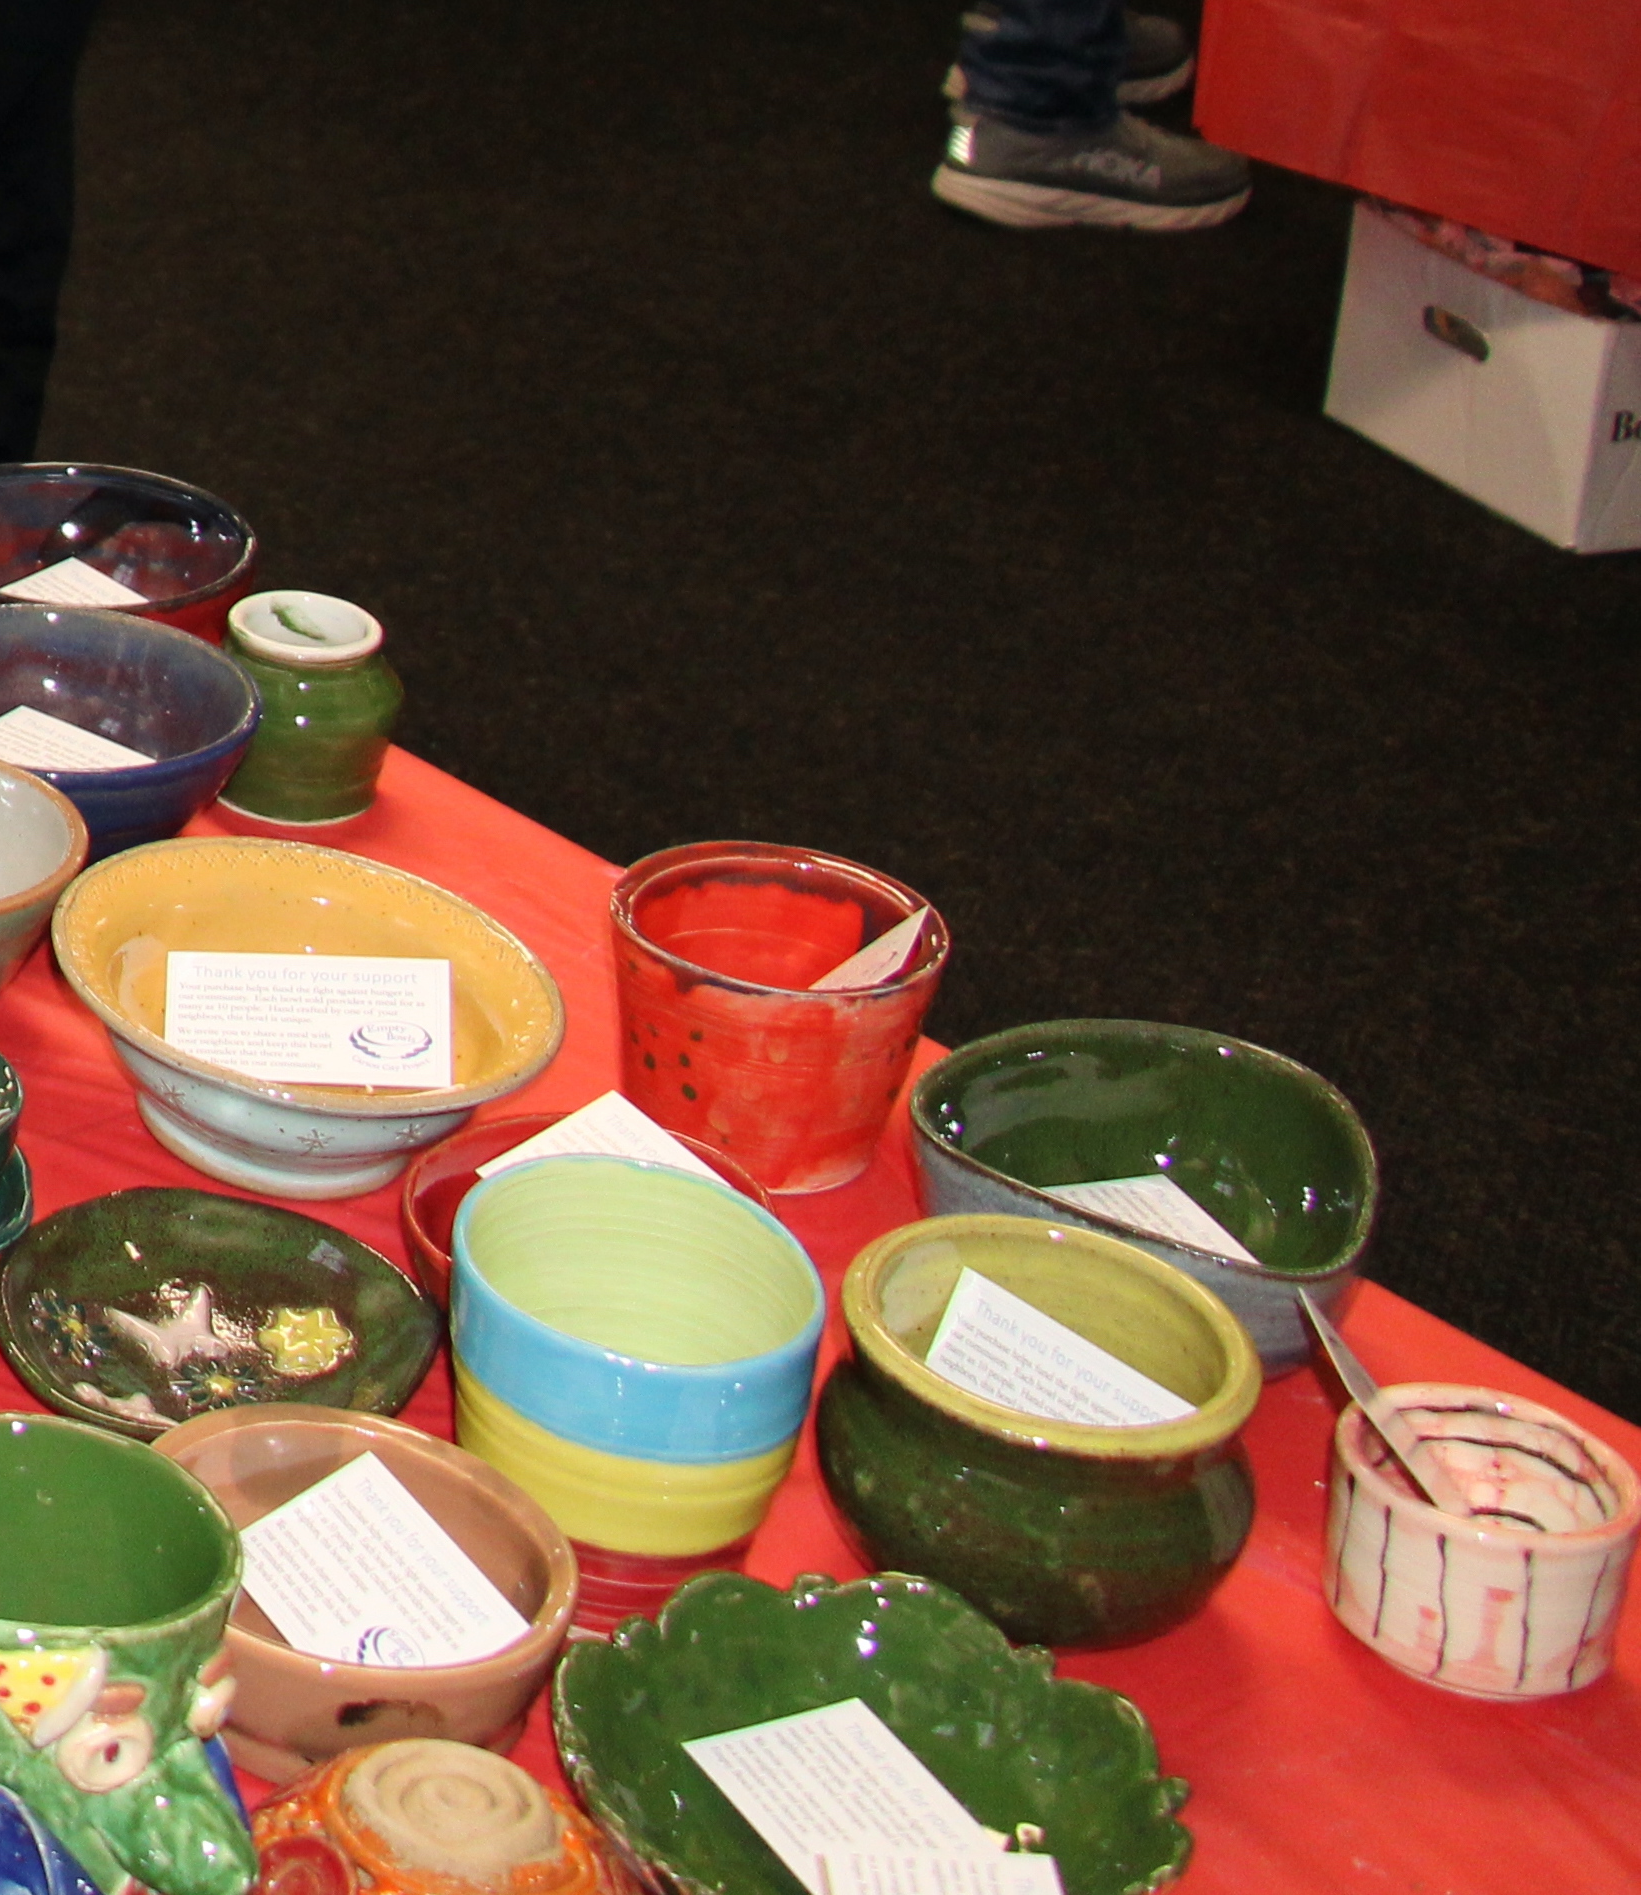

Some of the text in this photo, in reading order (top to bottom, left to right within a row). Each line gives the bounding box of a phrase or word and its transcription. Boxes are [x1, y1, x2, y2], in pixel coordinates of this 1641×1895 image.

[193, 964, 417, 985] Thank you for your support
[366, 1024, 407, 1034] Empty
[386, 1031, 416, 1044] Bowls
[351, 1054, 430, 1071] Carson City Project
[976, 1296, 1019, 1337] Thank
[1018, 1329, 1049, 1356] you
[1049, 1343, 1074, 1372] for
[1073, 1363, 1111, 1395] your
[355, 1475, 491, 1626] Thank you for your support
